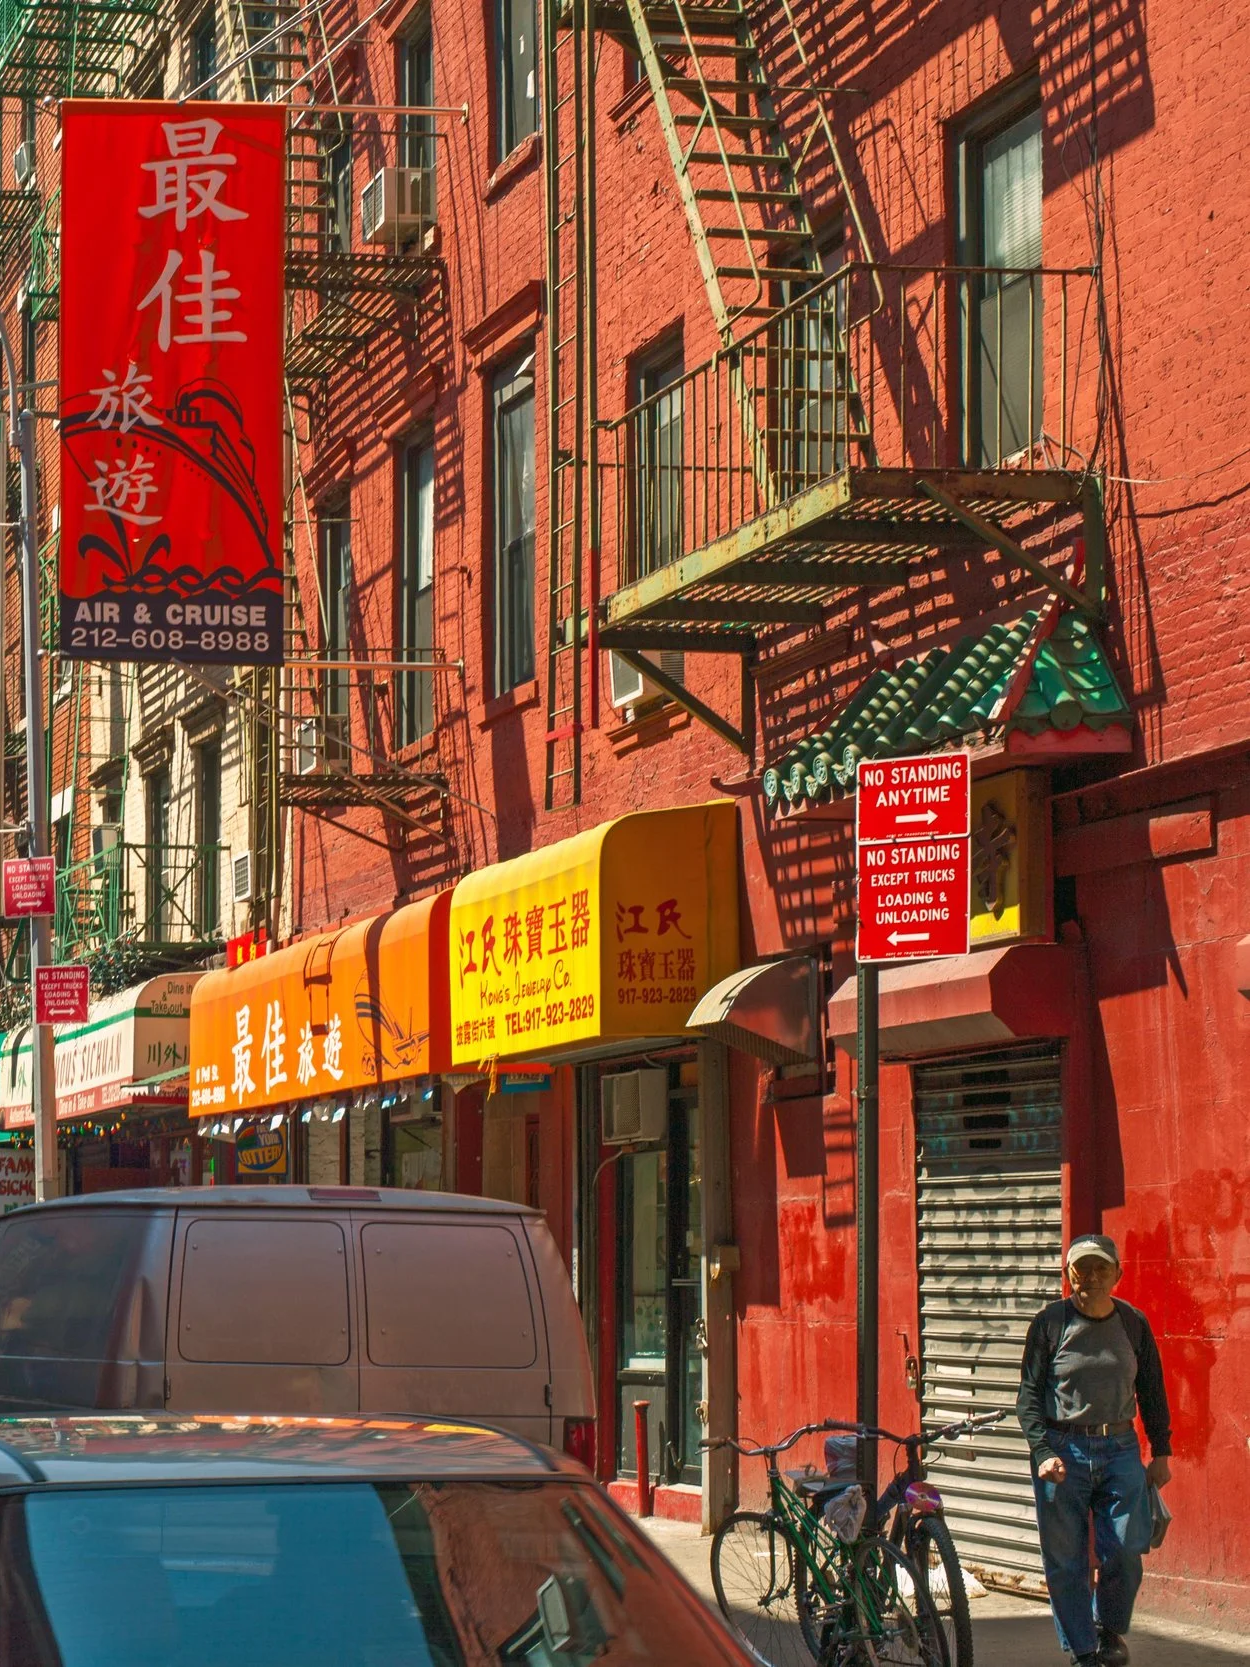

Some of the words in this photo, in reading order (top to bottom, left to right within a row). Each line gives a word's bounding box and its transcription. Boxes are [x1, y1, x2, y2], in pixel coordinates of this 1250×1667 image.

[74, 602, 119, 623] AIR
[134, 603, 152, 624] &
[166, 605, 266, 626] CRUISE
[71, 628, 270, 651] 212-608-8988
[864, 769, 884, 787] NO
[891, 762, 962, 784] STANDING
[876, 786, 950, 807] ANYTIME
[867, 850, 885, 866] NO
[891, 844, 960, 865] STANDING
[6, 865, 15, 873] NO
[19, 863, 51, 873] STANDING
[871, 872, 909, 887] EXCEPT
[915, 869, 955, 884] TRUCKS
[12, 883, 37, 892] LOADING
[878, 891, 933, 907] LOADING
[939, 892, 947, 902] &
[615, 899, 692, 943] 江氏
[875, 908, 949, 925] UNLOADING
[39, 972, 48, 980] NO
[51, 971, 85, 980] STANDING
[168, 981, 184, 994] Dine
[617, 986, 697, 1004] 917-923-2829
[151, 1000, 167, 1014] Take
[169, 1003, 182, 1013] out
[505, 994, 594, 1036] TEL:917-923-2829
[230, 999, 344, 1105] 最佳旅遊
[256, 1125, 271, 1133] NE
[258, 1133, 280, 1145] YORK
